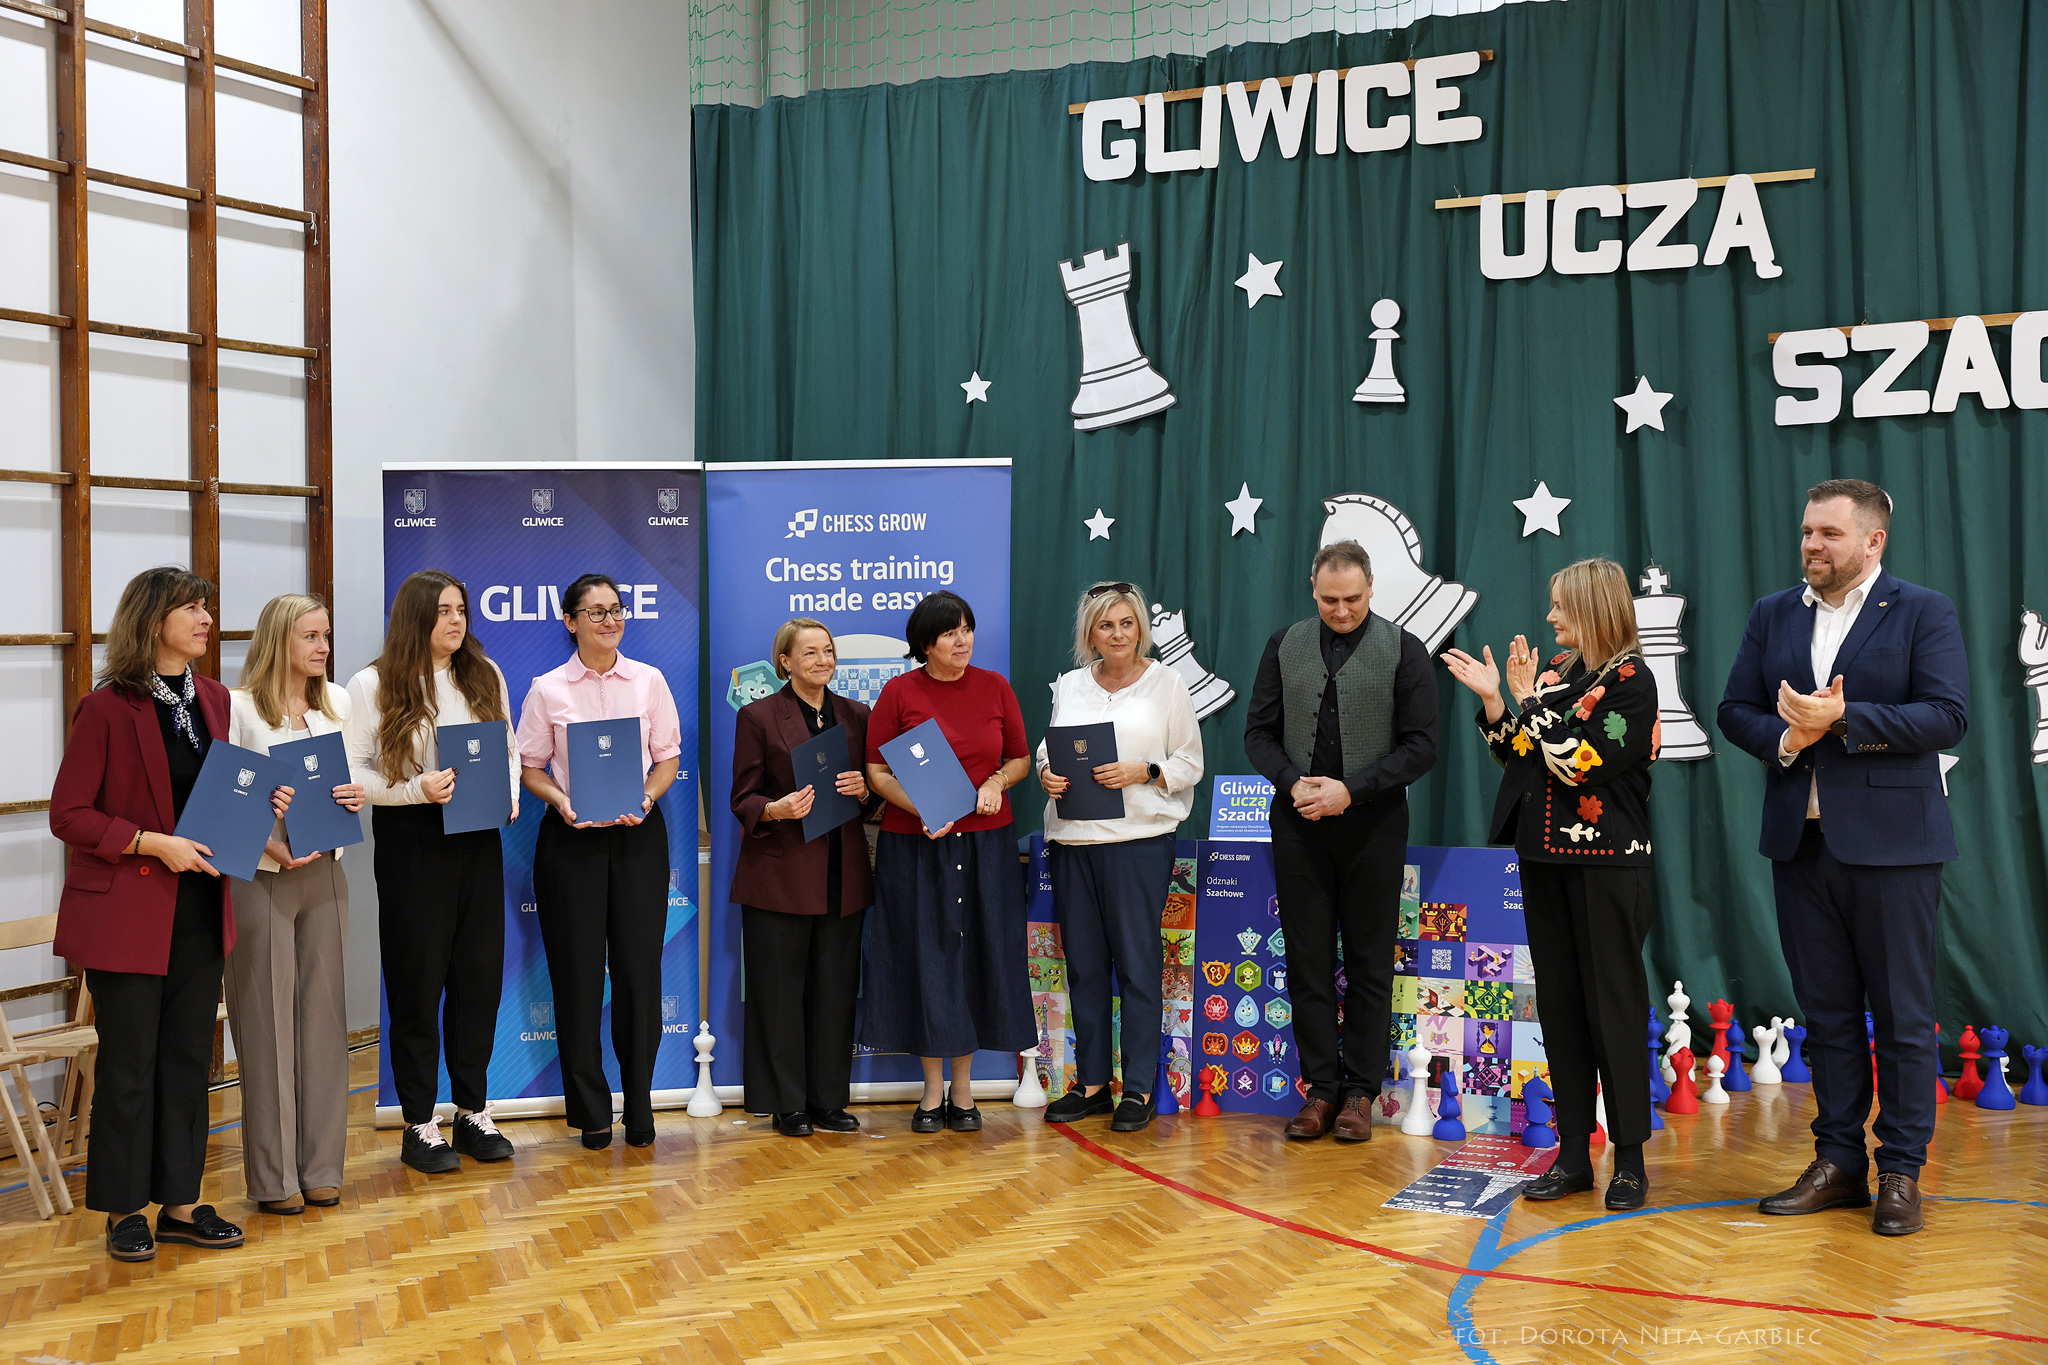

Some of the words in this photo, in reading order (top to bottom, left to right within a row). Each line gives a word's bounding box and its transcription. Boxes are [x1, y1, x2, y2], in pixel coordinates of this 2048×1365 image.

[1082, 50, 1484, 182] GLIWICE
[1479, 173, 1783, 281] UCZĄ
[394, 517, 437, 528] GLIWICE
[521, 517, 564, 528] GLIWICE
[647, 516, 690, 527] GLIWICE
[822, 513, 875, 533] CHESS
[878, 512, 928, 532] GROW
[765, 556, 843, 583] Chess
[850, 554, 955, 586] training
[789, 586, 863, 612] made
[1219, 781, 1277, 795] Gliwice
[1230, 796, 1268, 810] uczą
[1219, 853, 1236, 861] CHESS
[1235, 854, 1251, 862] GROW
[1206, 876, 1238, 886] Odznaki
[1206, 888, 1245, 898] Szachowe
